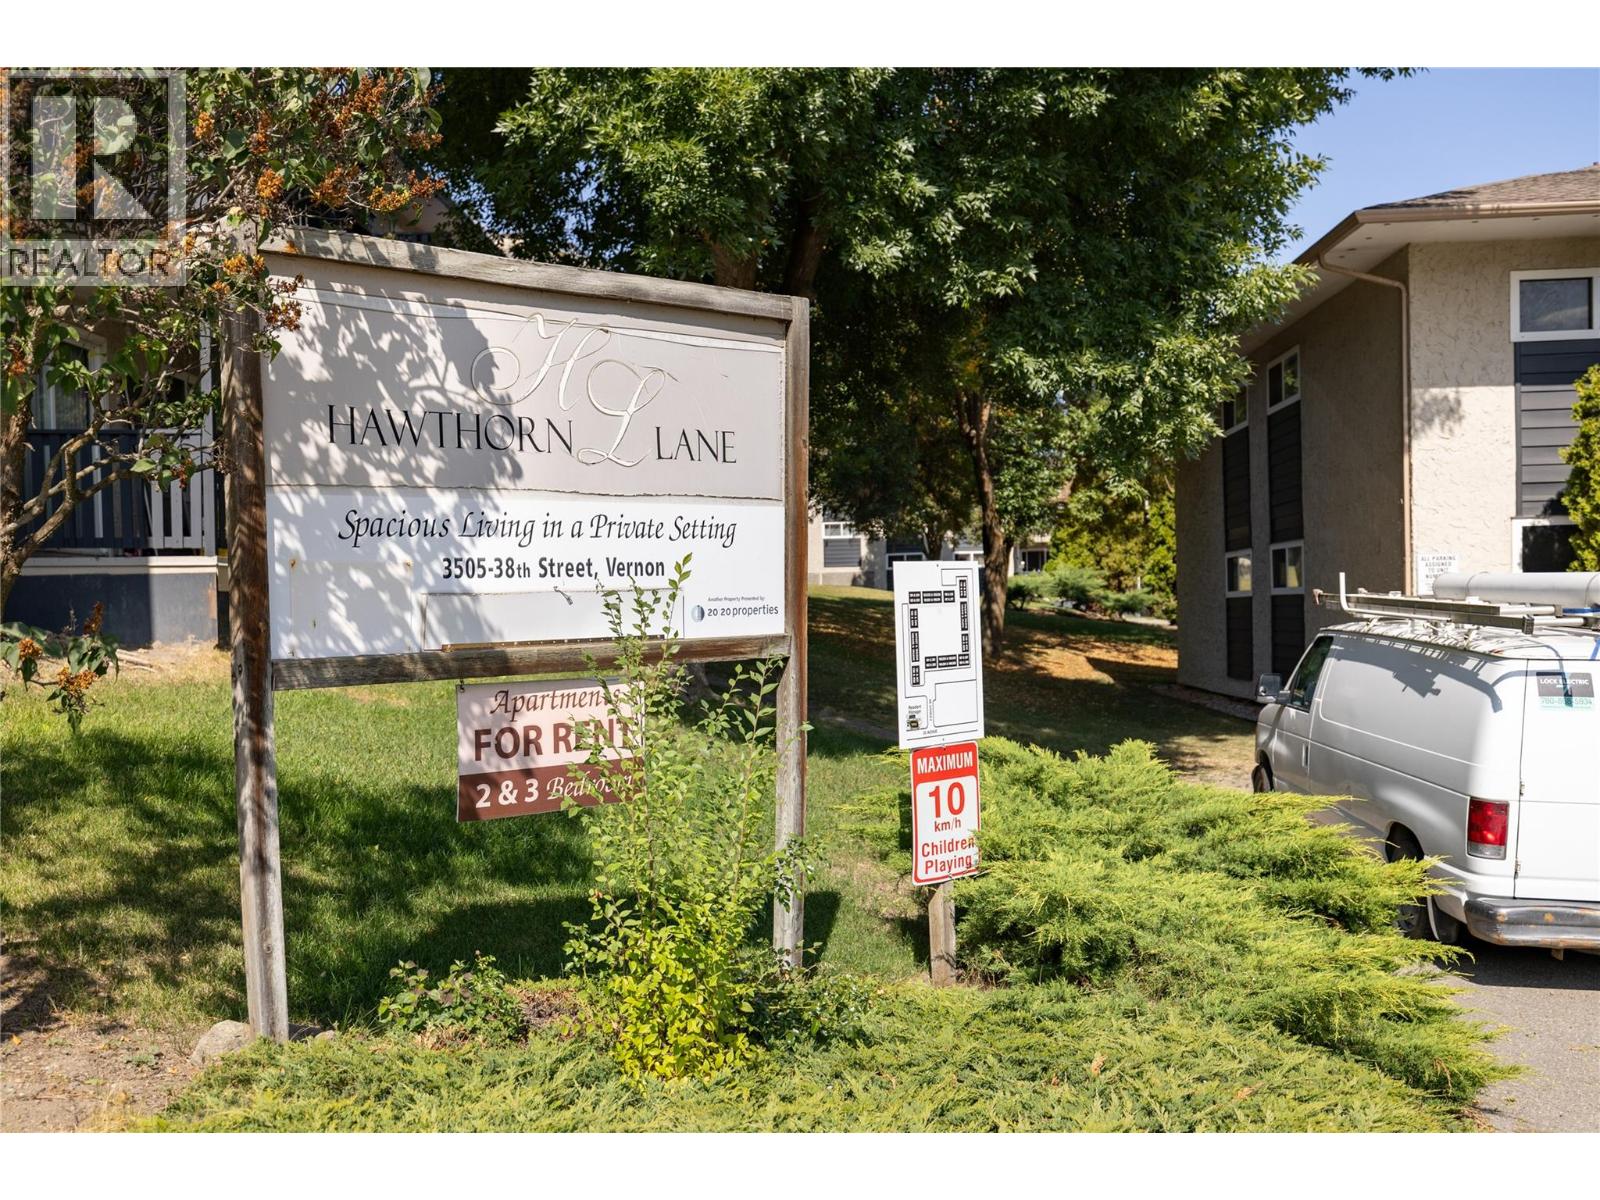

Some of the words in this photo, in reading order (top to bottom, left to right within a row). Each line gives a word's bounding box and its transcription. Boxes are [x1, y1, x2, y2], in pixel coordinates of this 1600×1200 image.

[327, 404, 573, 455] HAWTHORN
[655, 426, 737, 464] LANE
[338, 509, 450, 548] Spacious
[458, 511, 535, 548] Living
[542, 512, 564, 539] in
[570, 519, 584, 539] a
[590, 514, 665, 539] Private
[668, 515, 737, 549] Setting
[442, 556, 530, 579] 3505-38th
[538, 556, 599, 580] Street,
[605, 557, 665, 577] Vernon
[732, 604, 779, 617] properties
[474, 724, 543, 761] FOR
[917, 751, 973, 774] MAXIMUM
[475, 784, 491, 808] 2
[498, 780, 518, 805] &
[524, 778, 539, 802] 3
[928, 781, 965, 818] 10
[934, 817, 961, 832] km/h
[922, 836, 975, 857] Children
[925, 854, 972, 874] Playing
